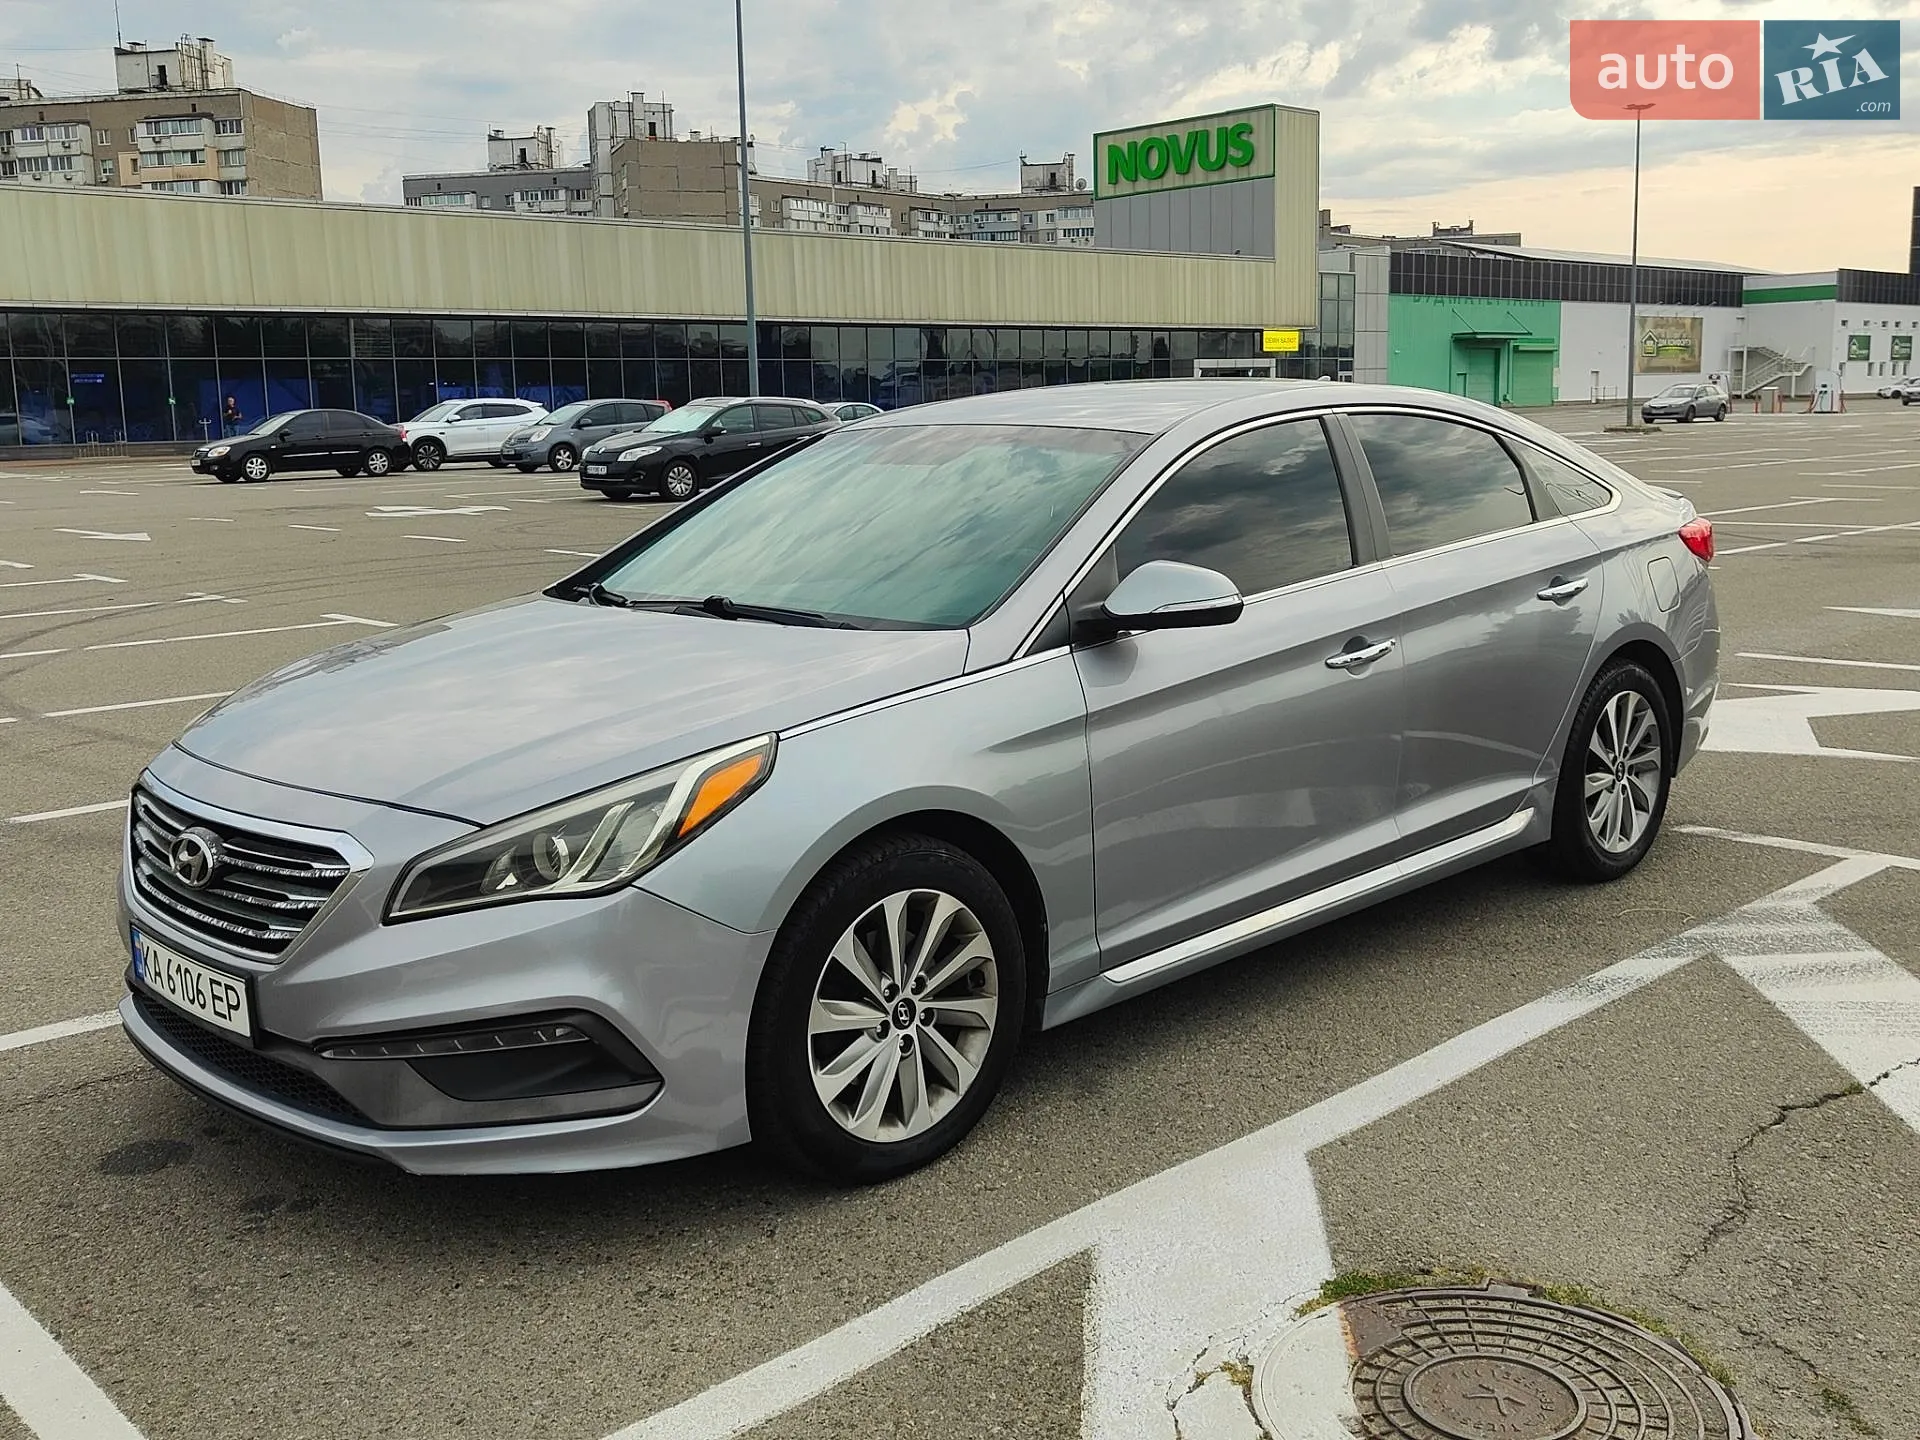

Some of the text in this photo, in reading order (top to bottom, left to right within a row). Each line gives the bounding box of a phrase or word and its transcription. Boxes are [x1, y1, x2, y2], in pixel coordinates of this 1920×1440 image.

[1107, 122, 1255, 186] NOVUS
[141, 940, 241, 1022] KA 6106 EP
